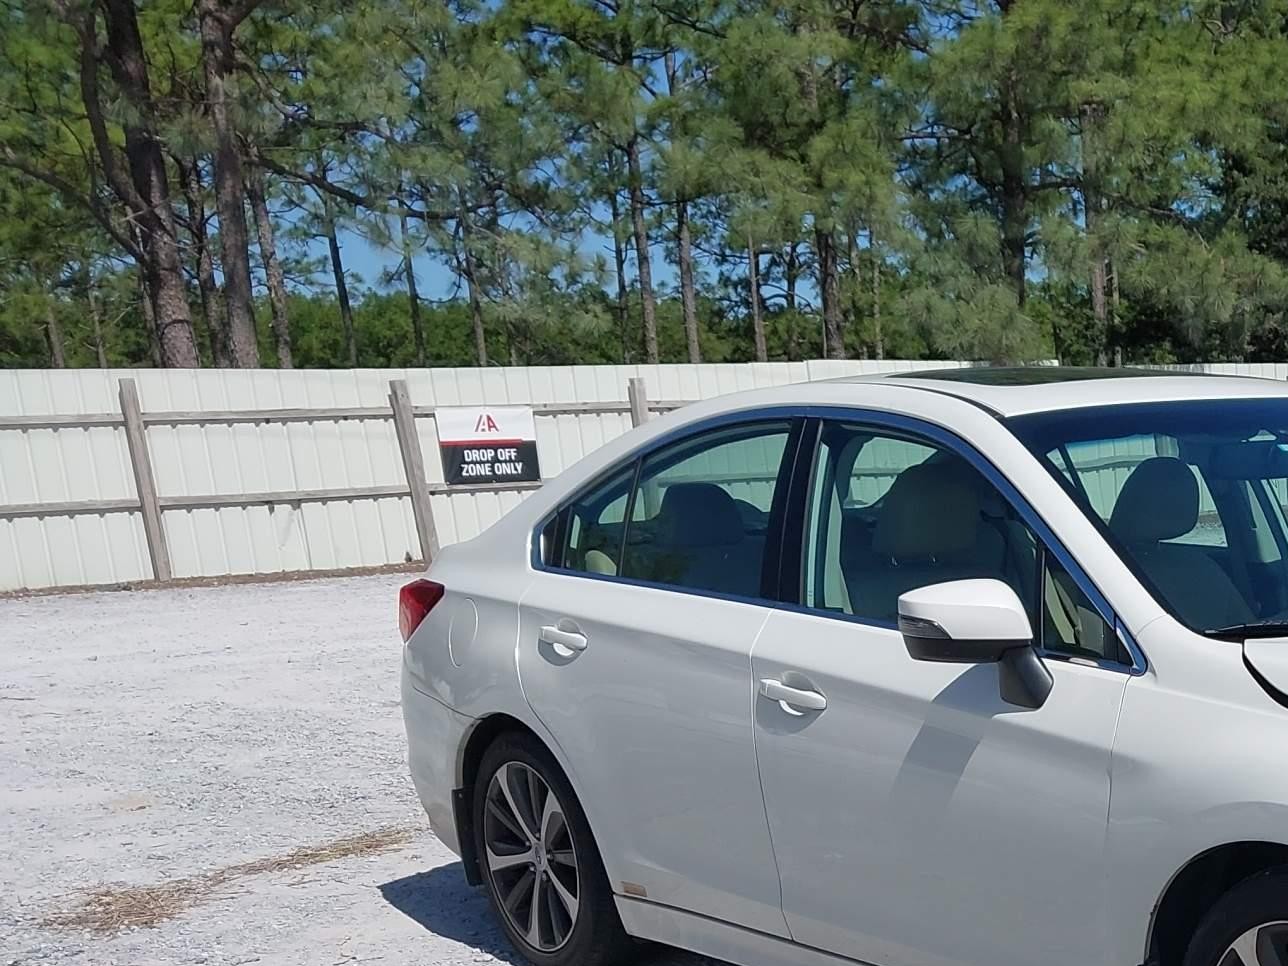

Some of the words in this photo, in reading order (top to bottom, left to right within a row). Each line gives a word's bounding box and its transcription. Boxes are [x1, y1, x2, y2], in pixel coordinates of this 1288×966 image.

[463, 449, 495, 462] DROP
[497, 448, 518, 461] OFF
[461, 464, 493, 476] ZONE
[494, 462, 523, 475] ONLY
